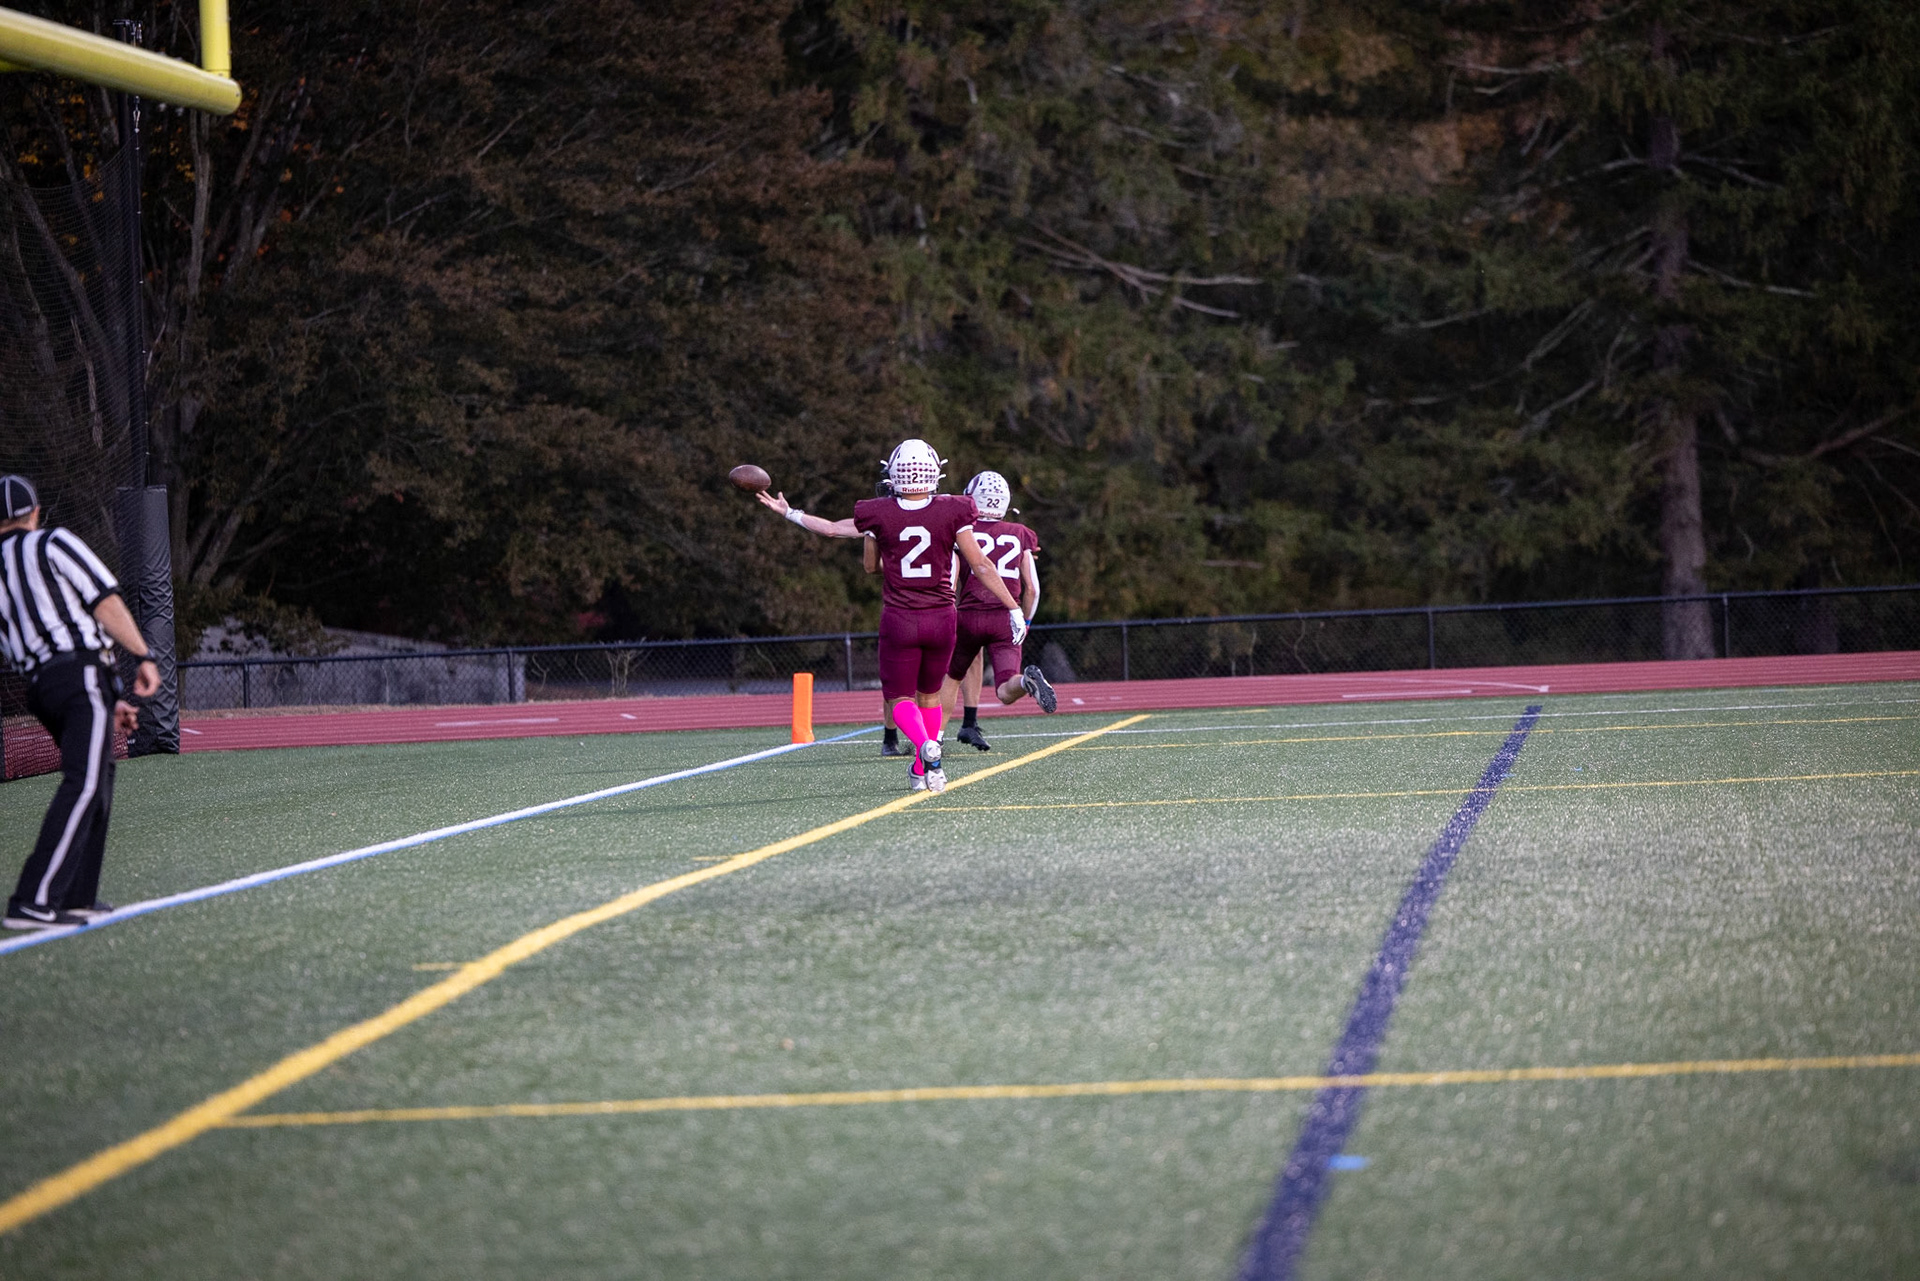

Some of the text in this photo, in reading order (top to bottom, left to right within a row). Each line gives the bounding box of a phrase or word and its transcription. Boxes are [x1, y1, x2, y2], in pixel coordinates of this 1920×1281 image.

[911, 473, 918, 483] 2
[987, 498, 1000, 508] 22
[899, 526, 932, 578] 2
